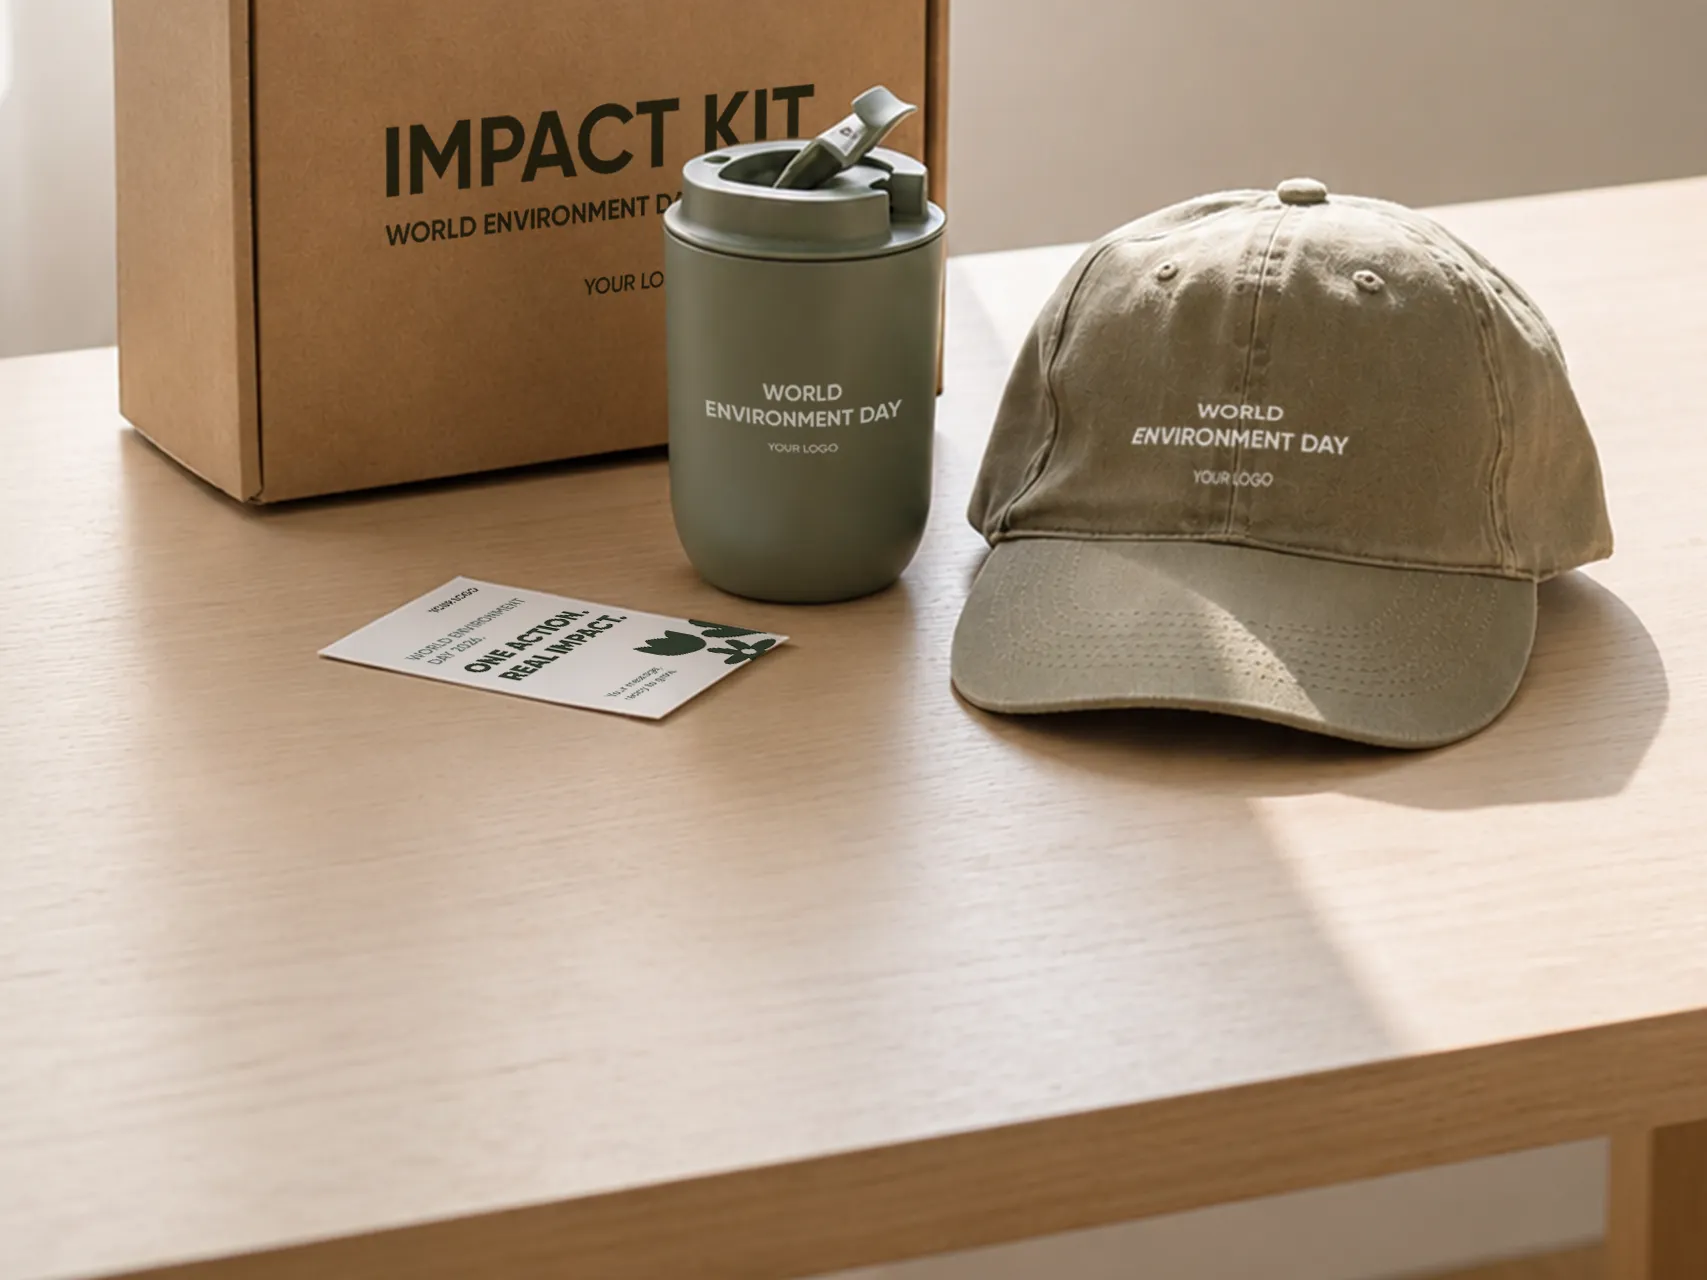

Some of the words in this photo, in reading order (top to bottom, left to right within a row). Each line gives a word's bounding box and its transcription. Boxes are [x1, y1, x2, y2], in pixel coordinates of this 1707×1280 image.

[385, 97, 680, 198] IMPACT
[704, 83, 815, 153] KIT
[385, 215, 477, 247] WORLD
[483, 195, 651, 236] ENVIRONMENT
[583, 273, 636, 296] YOUR
[762, 382, 843, 403] WORLD
[705, 400, 855, 428] ENVIRONMENT
[859, 399, 903, 425] DAY
[1197, 402, 1285, 422] WORLD
[767, 442, 801, 454] YOUR
[802, 442, 839, 454] LOGO
[1130, 426, 1296, 452] ENVIRONMENT
[1300, 432, 1350, 456] DAY
[1193, 469, 1231, 485] YOUR
[1232, 471, 1274, 488] LOGO
[405, 637, 453, 661] WORLD
[448, 597, 525, 638] ENVIRONMENT
[463, 649, 517, 673] ONE
[505, 610, 590, 651] ACTION.
[427, 651, 456, 665] DAY
[498, 654, 560, 681] REAL
[544, 614, 628, 654] IMPACT.
